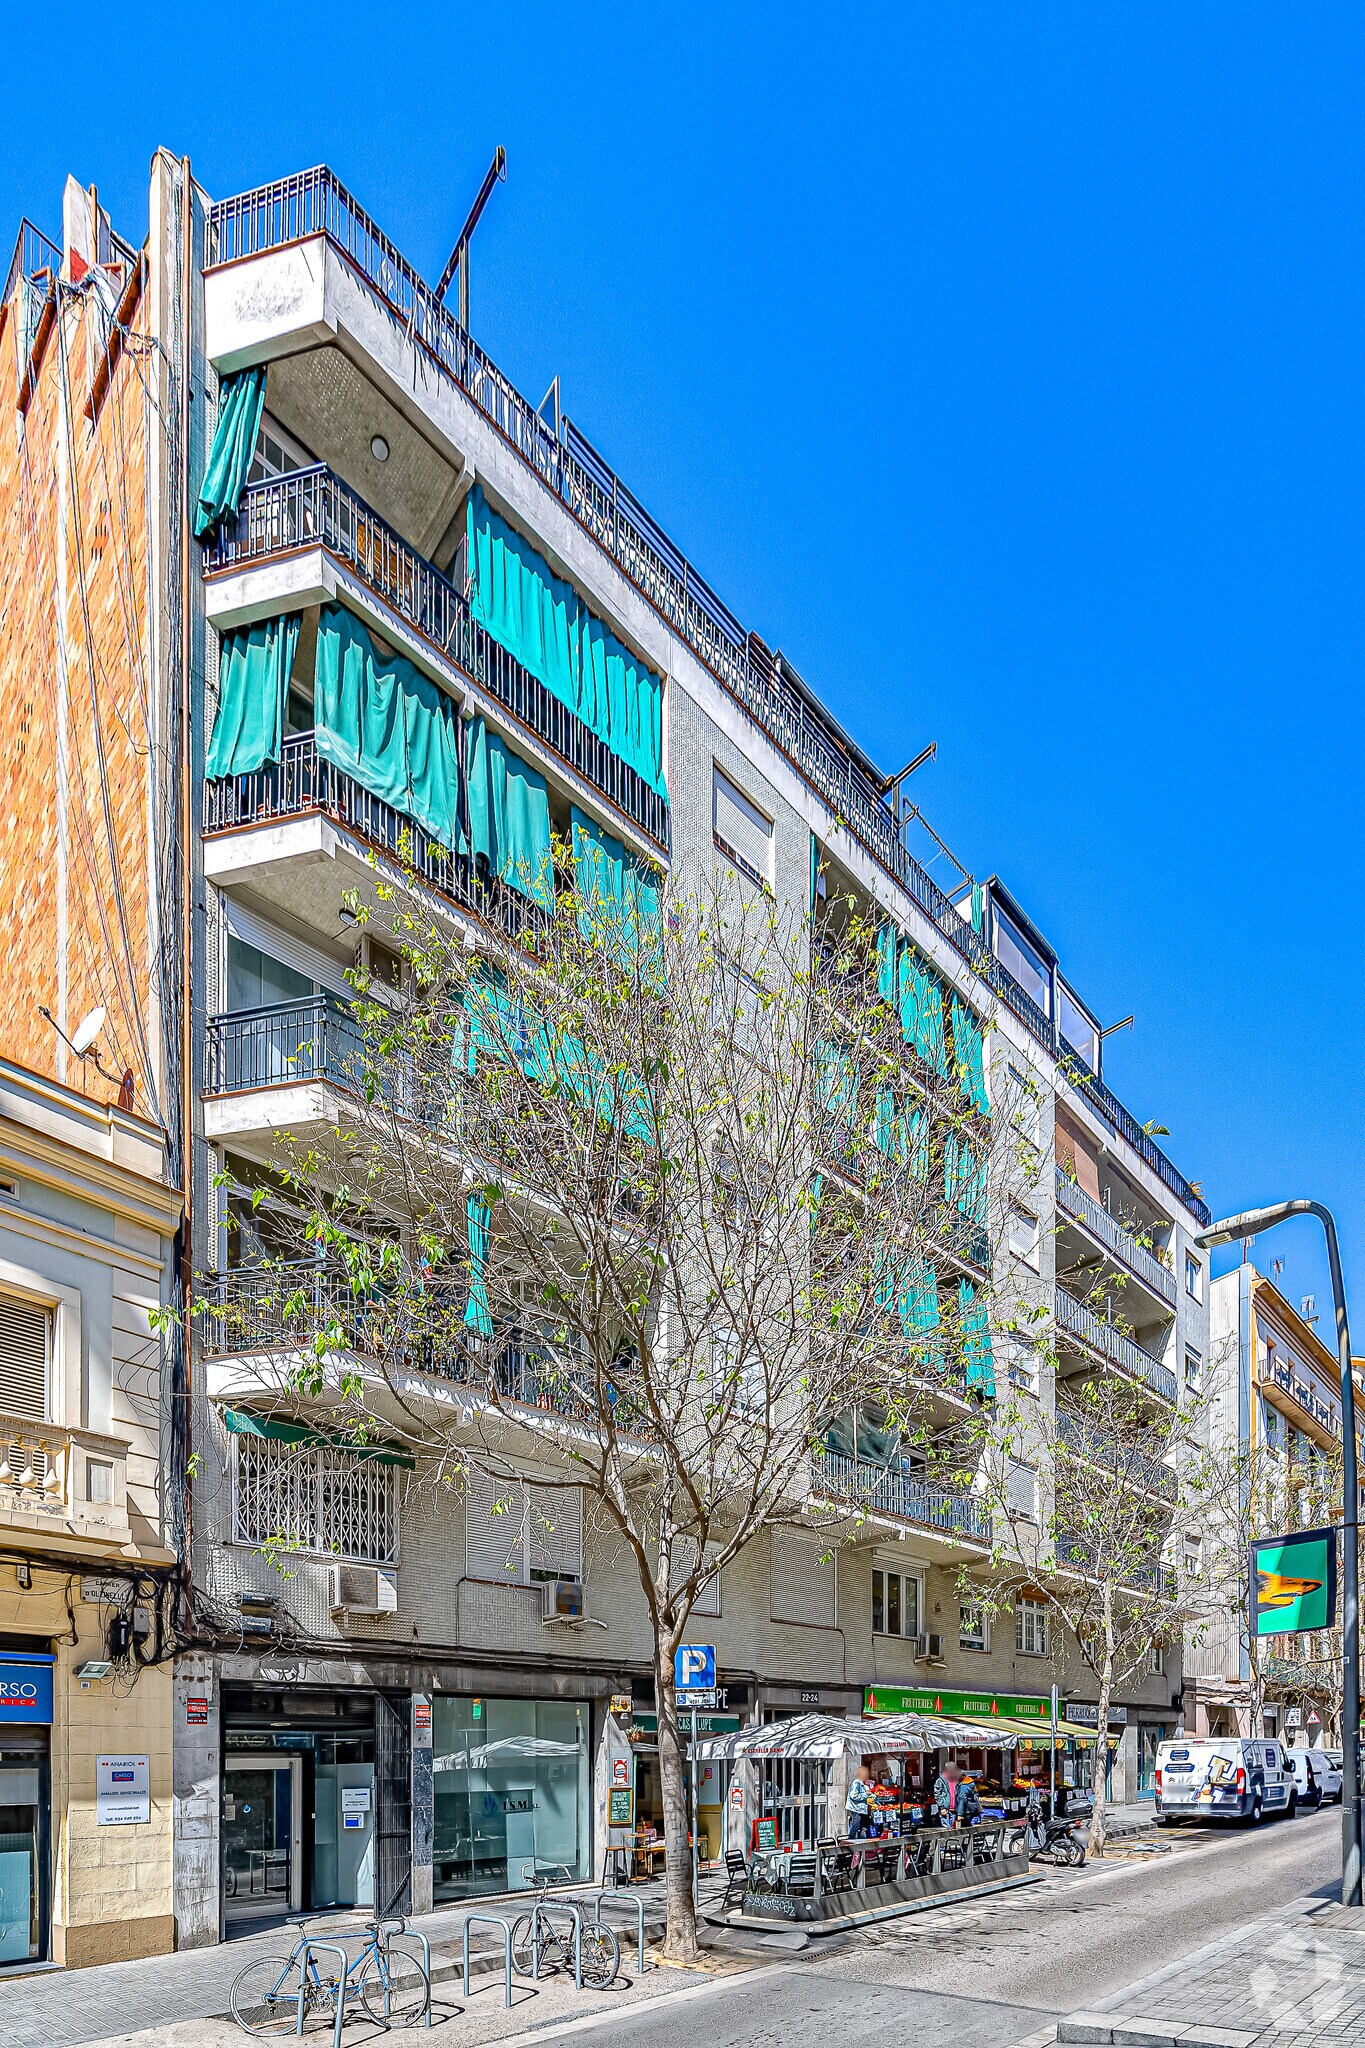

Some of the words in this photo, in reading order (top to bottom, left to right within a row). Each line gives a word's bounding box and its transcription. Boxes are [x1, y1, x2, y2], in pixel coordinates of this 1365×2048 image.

[682, 1650, 707, 1685] P
[0, 1682, 37, 1697] RSO
[801, 1693, 818, 1702] 22-24
[901, 1697, 933, 1709] FRUITERIES
[963, 1700, 990, 1711] FRUITERIES
[678, 1717, 697, 1731] CAS
[697, 1718, 713, 1731] LUPE
